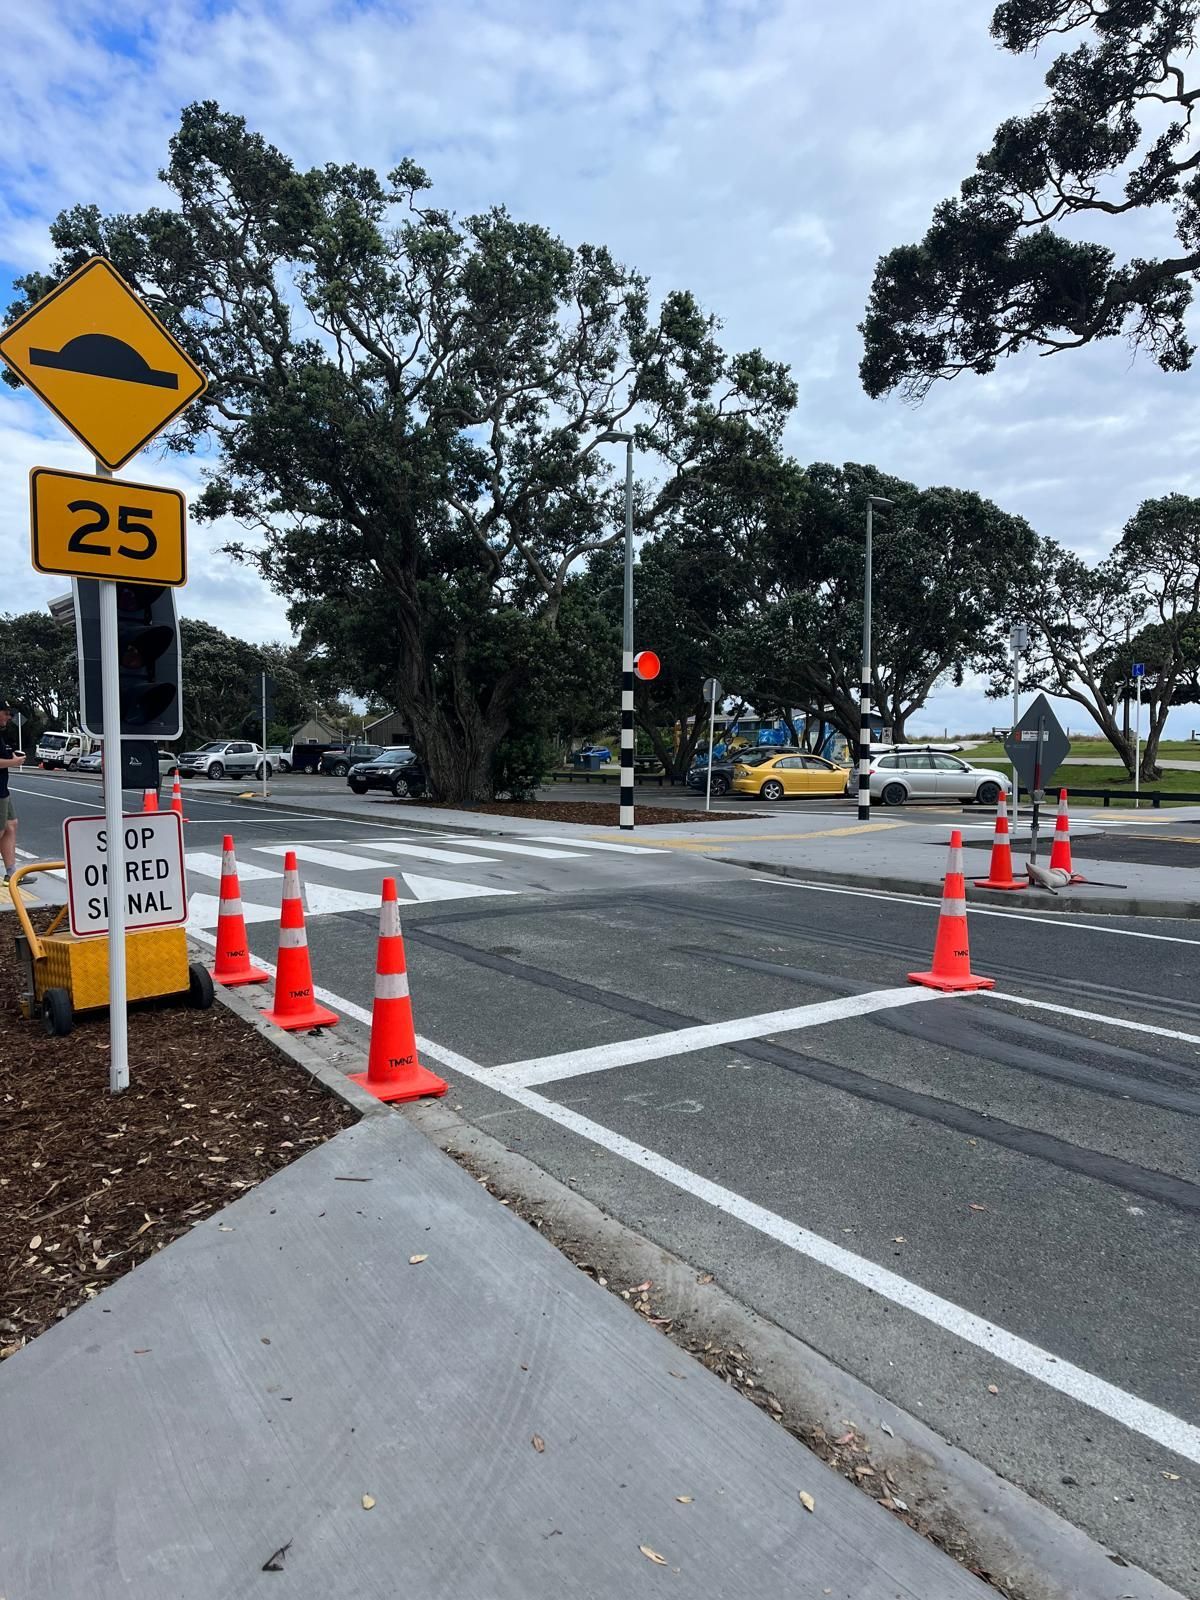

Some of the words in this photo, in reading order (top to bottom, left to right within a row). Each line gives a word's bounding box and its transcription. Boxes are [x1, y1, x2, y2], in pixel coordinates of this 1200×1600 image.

[67, 500, 157, 560] 25
[96, 828, 154, 852] SOP
[125, 859, 169, 882] RED
[88, 890, 172, 919] SINAL
[226, 950, 245, 958] TMNZ
[289, 989, 310, 998] TMNZ
[389, 1056, 413, 1068] TMNZ
